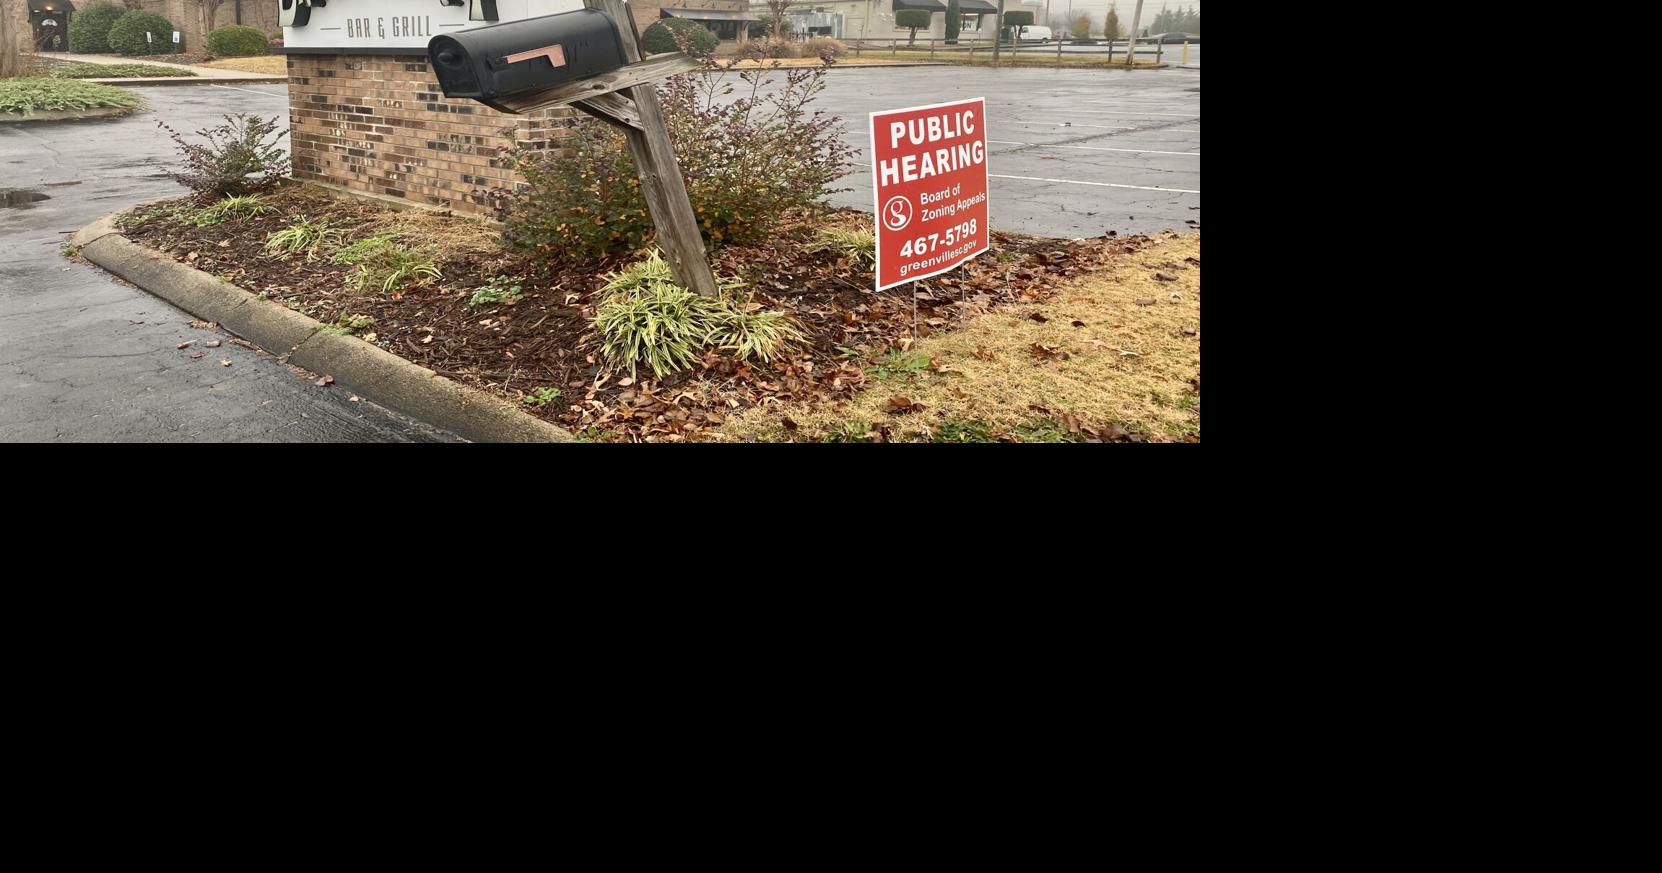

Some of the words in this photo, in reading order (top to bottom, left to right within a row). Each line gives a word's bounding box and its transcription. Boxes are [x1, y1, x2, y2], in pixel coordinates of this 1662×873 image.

[347, 18, 371, 38] BAR
[378, 17, 385, 39] &
[392, 15, 432, 37] GRILL
[890, 110, 975, 149] PUBLIC
[880, 139, 984, 187] HEARING
[920, 187, 950, 205] Board
[952, 182, 961, 196] of
[921, 203, 955, 222] Zoning
[956, 191, 986, 211] Appeals
[900, 218, 977, 258] 467-5798
[900, 239, 977, 276] greenvillesc.gov
